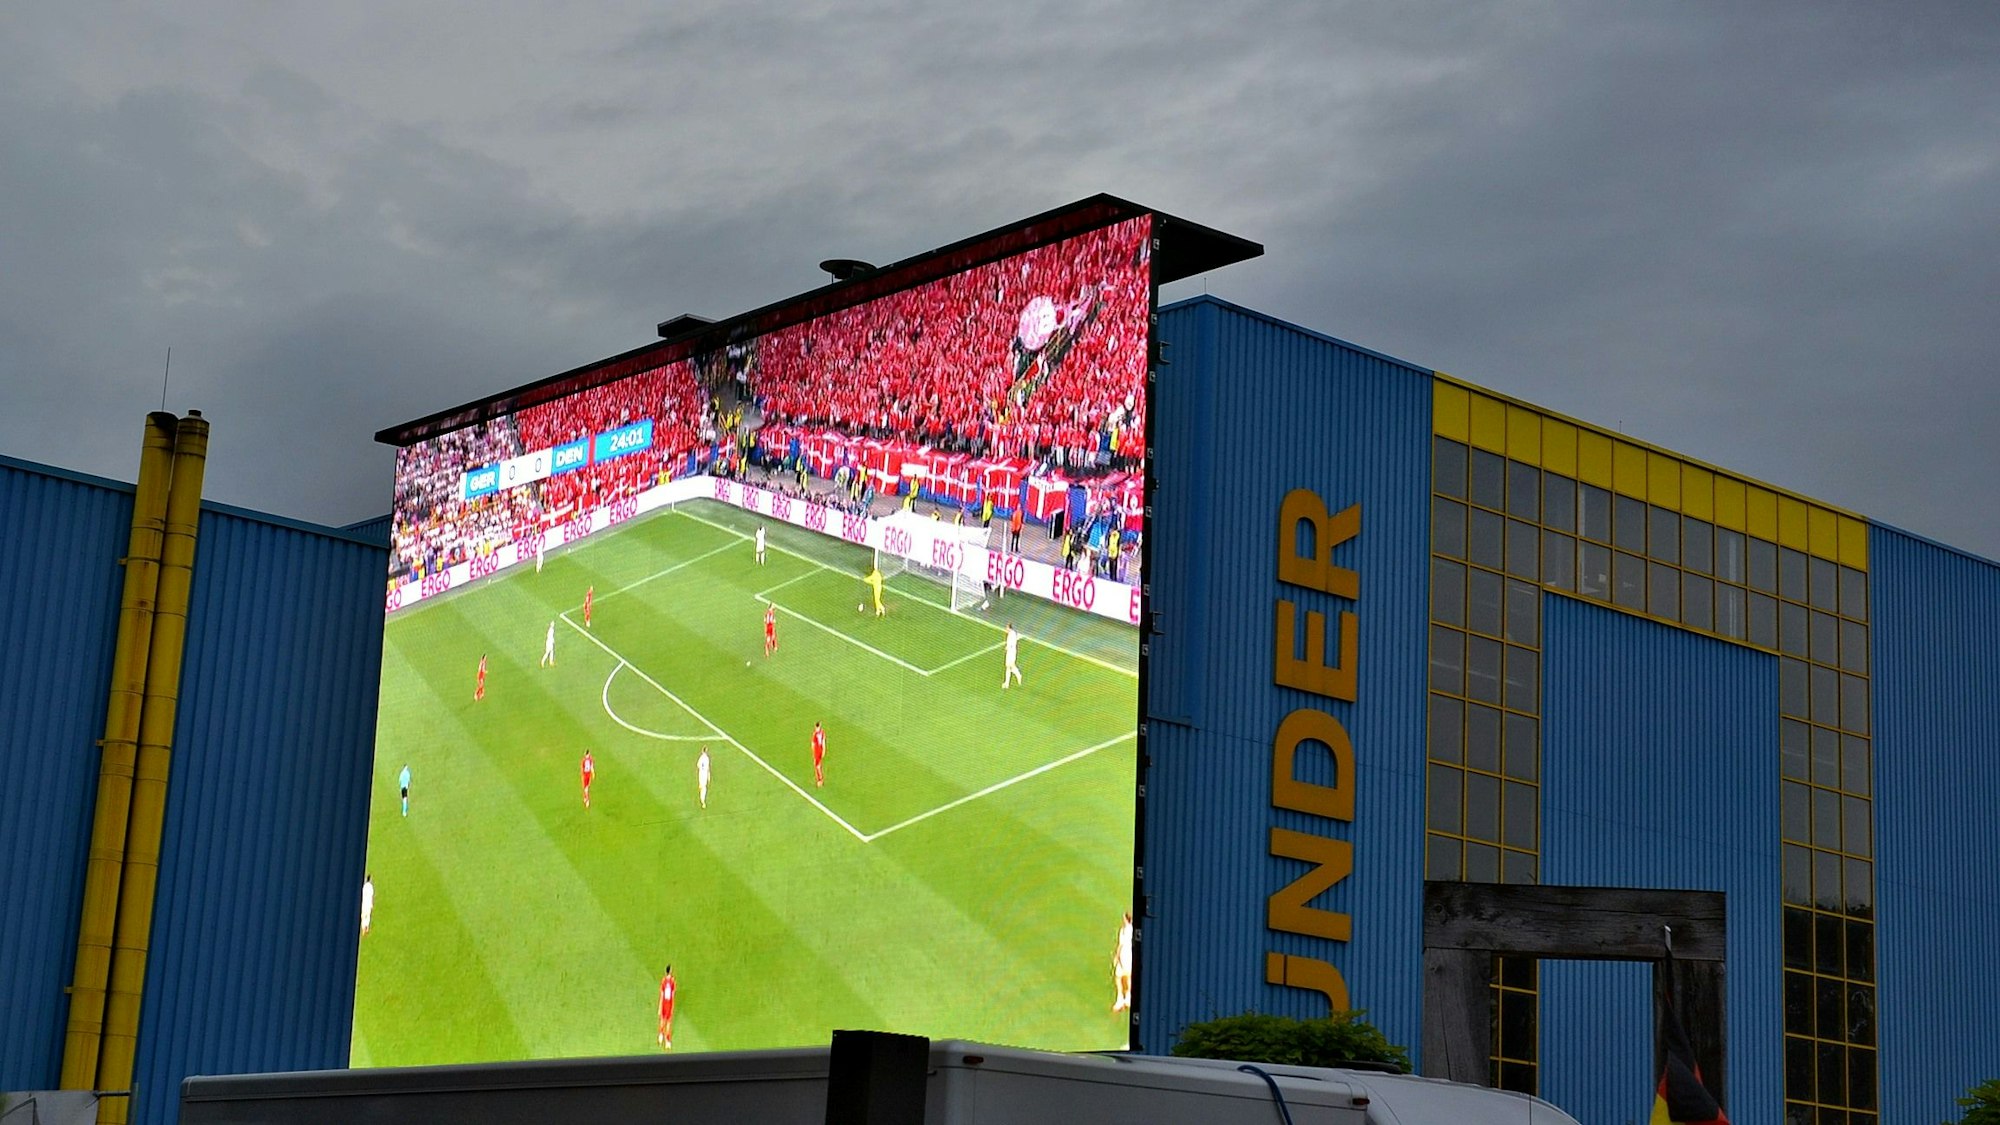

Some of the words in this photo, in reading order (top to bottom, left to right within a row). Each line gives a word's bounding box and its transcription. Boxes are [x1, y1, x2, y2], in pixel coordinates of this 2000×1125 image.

[469, 471, 496, 491] GER
[508, 465, 516, 480] 0
[534, 457, 542, 473] 0
[555, 446, 584, 468] DEN
[609, 426, 645, 451] 24:01
[421, 570, 451, 597] ERGO
[469, 550, 499, 578] ERGO
[516, 535, 546, 560] ERGO
[563, 515, 592, 542] ERGO
[609, 496, 638, 524] ERGO
[805, 501, 827, 531] ERGO
[842, 511, 868, 542] ERGO
[884, 526, 912, 555] ERGO
[987, 550, 1025, 589] ERGO
[1052, 567, 1096, 610] ERGO
